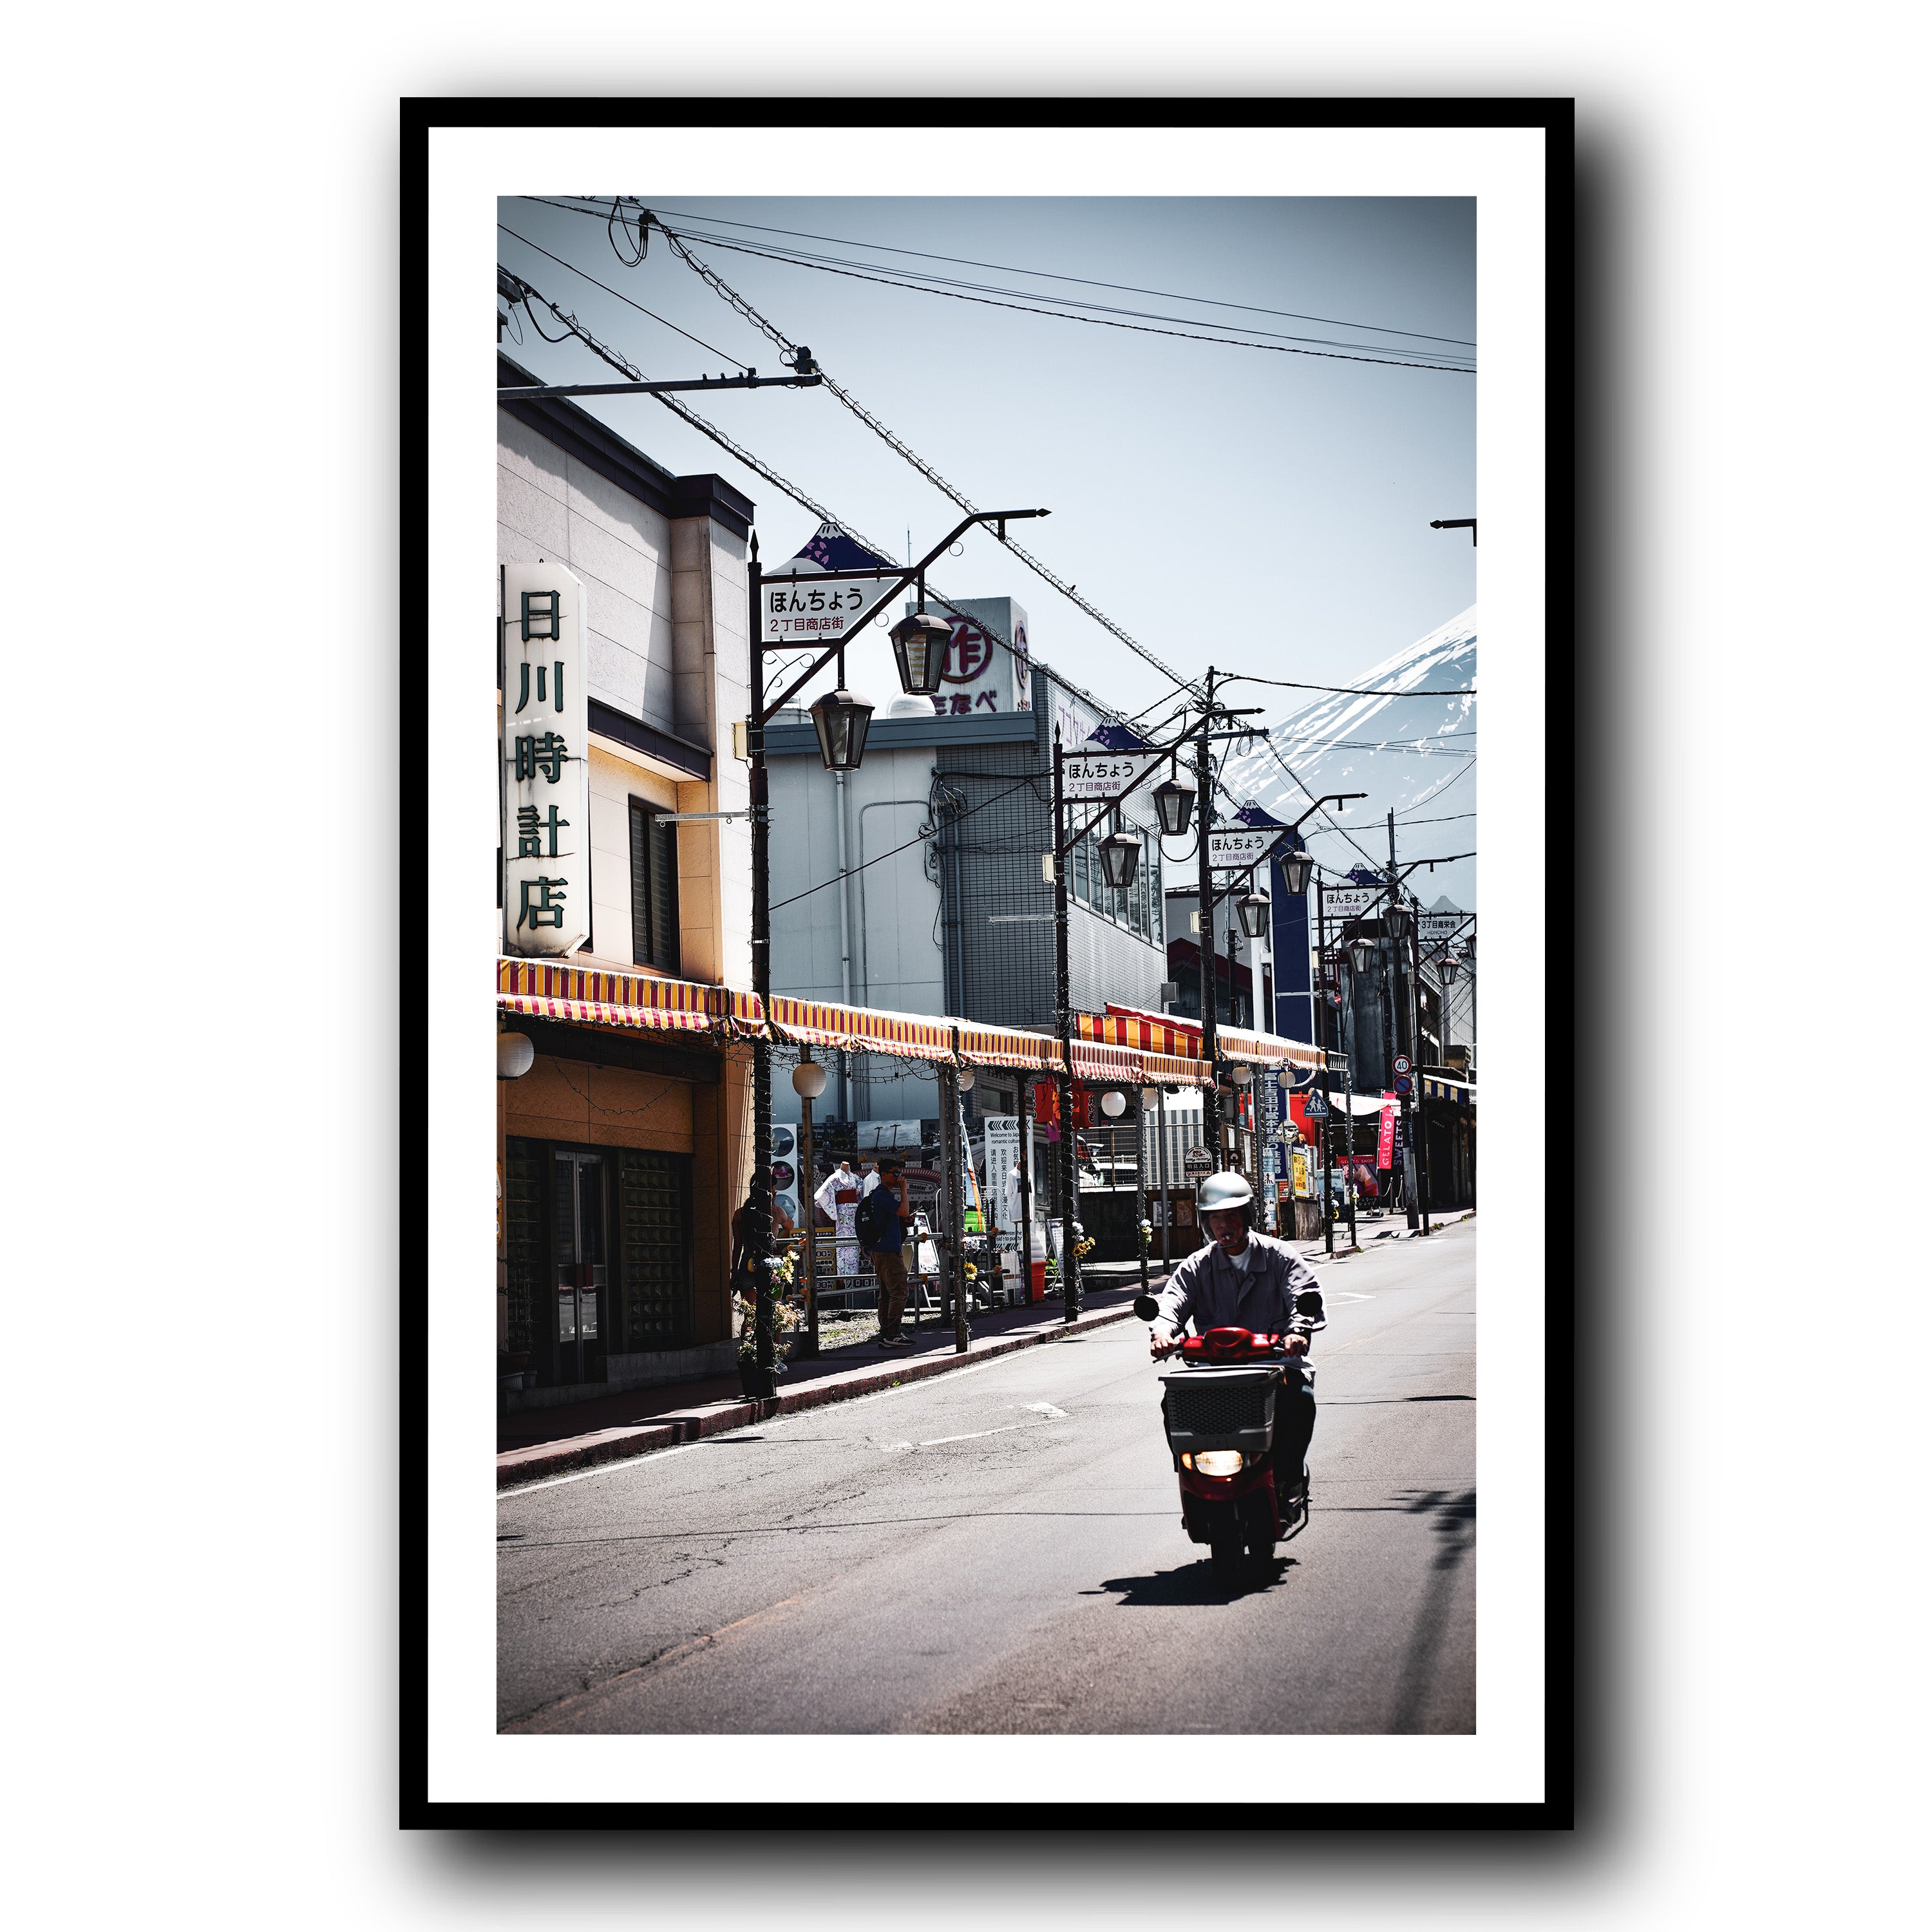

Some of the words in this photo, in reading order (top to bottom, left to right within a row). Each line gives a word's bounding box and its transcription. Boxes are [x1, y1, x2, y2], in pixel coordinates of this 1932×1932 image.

[770, 587, 864, 614] ほんちょう
[770, 616, 844, 633] 2丁目商店街
[515, 589, 570, 931] 日川時計店
[1068, 761, 1134, 779] ほんちょう
[1068, 781, 1121, 792] 2丁目商店街
[1211, 836, 1264, 851] ほんちょう
[1212, 853, 1254, 862] 2丁目商店街
[1326, 892, 1370, 904] ほんちょう
[1421, 920, 1456, 929] 3丁目商栄会
[1397, 1061, 1407, 1070] 40
[1382, 1120, 1392, 1166] GELATO
[1394, 1119, 1404, 1166] SWEETS
